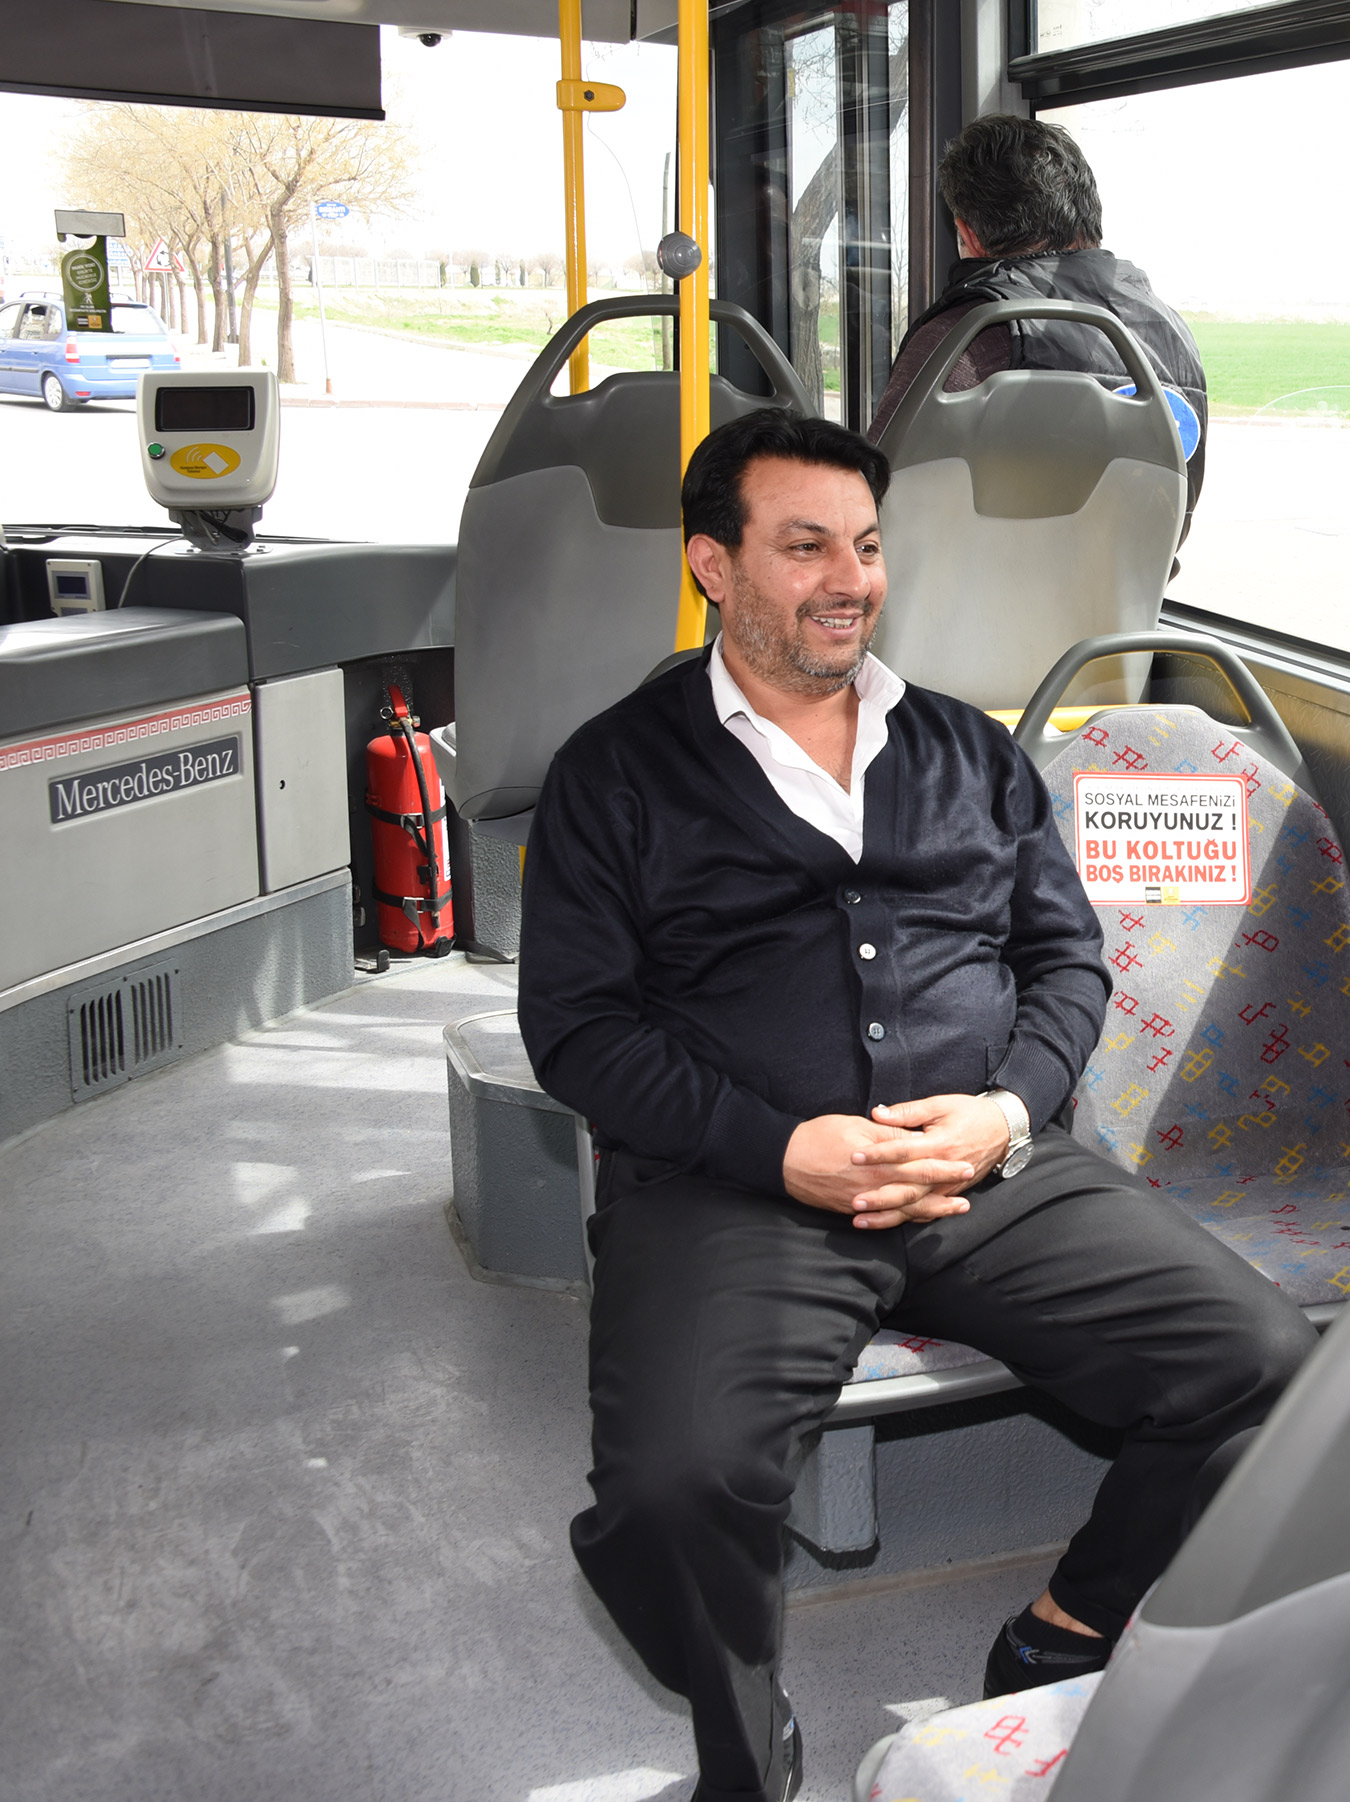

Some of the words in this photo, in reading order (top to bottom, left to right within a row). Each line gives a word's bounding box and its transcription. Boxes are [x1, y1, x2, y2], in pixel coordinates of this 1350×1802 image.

[55, 749, 235, 820] Mercedes-Benz
[1084, 792, 1143, 806] SOSYAL
[1085, 810, 1224, 831] KORUYUNUZ
[1085, 839, 1117, 860] BU
[1126, 838, 1237, 861] KOLTUĞU
[1085, 864, 1125, 884] BOŞ
[1129, 864, 1227, 883] BIRAKINIZ
